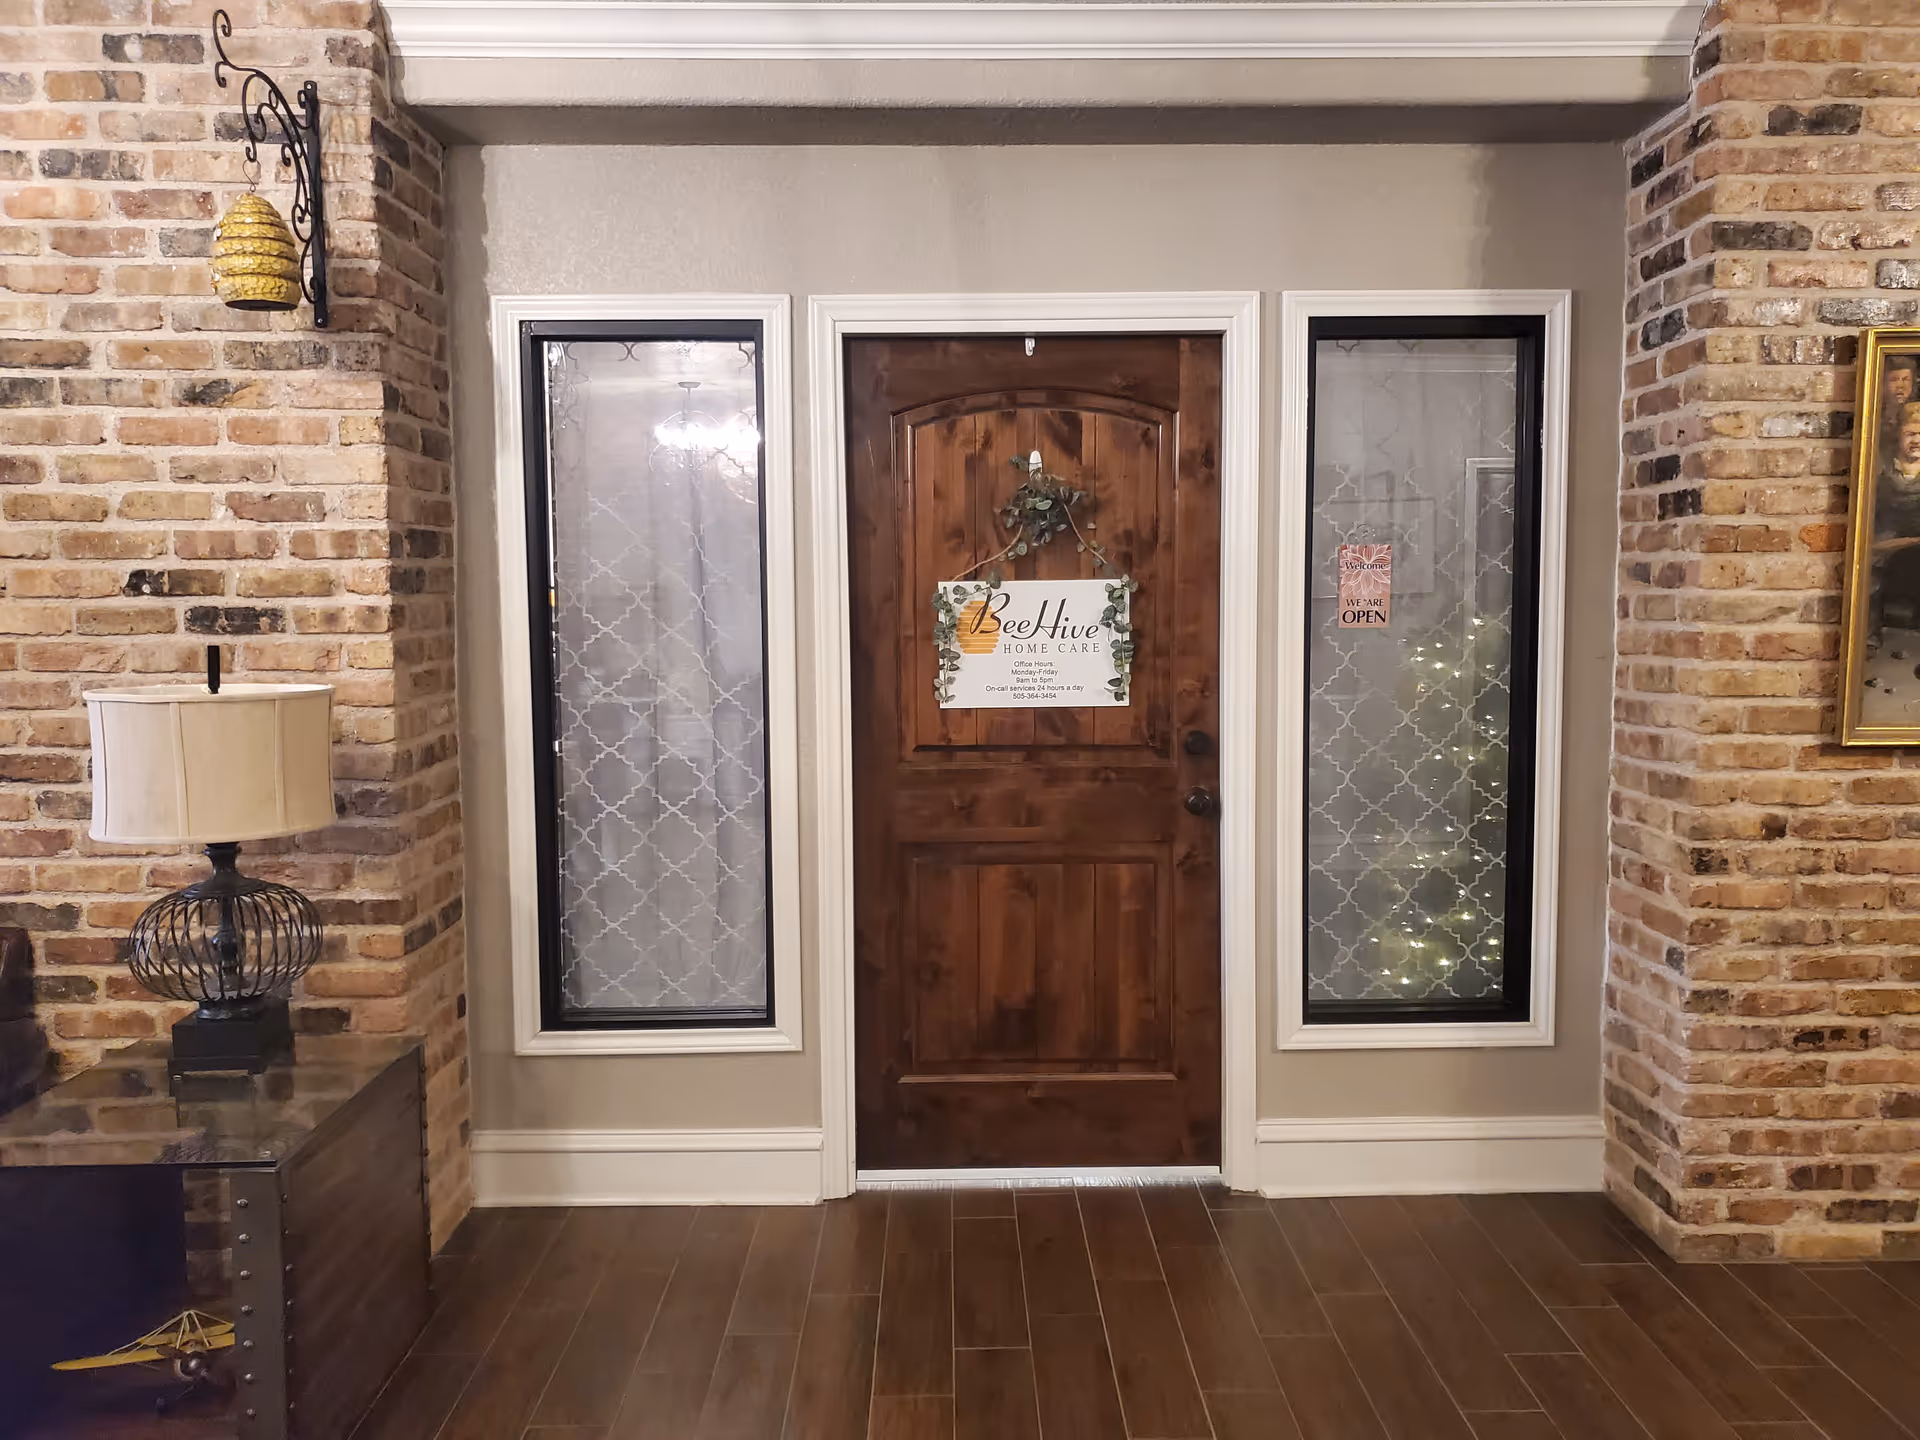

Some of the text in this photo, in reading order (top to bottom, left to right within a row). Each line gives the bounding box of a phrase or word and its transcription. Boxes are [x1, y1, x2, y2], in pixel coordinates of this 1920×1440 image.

[1345, 562, 1386, 570] Welcome
[970, 593, 1099, 640] BeeHive
[1342, 610, 1386, 623] OPEN
[1004, 643, 1100, 653] HOME CARE
[1072, 684, 1084, 692] day
